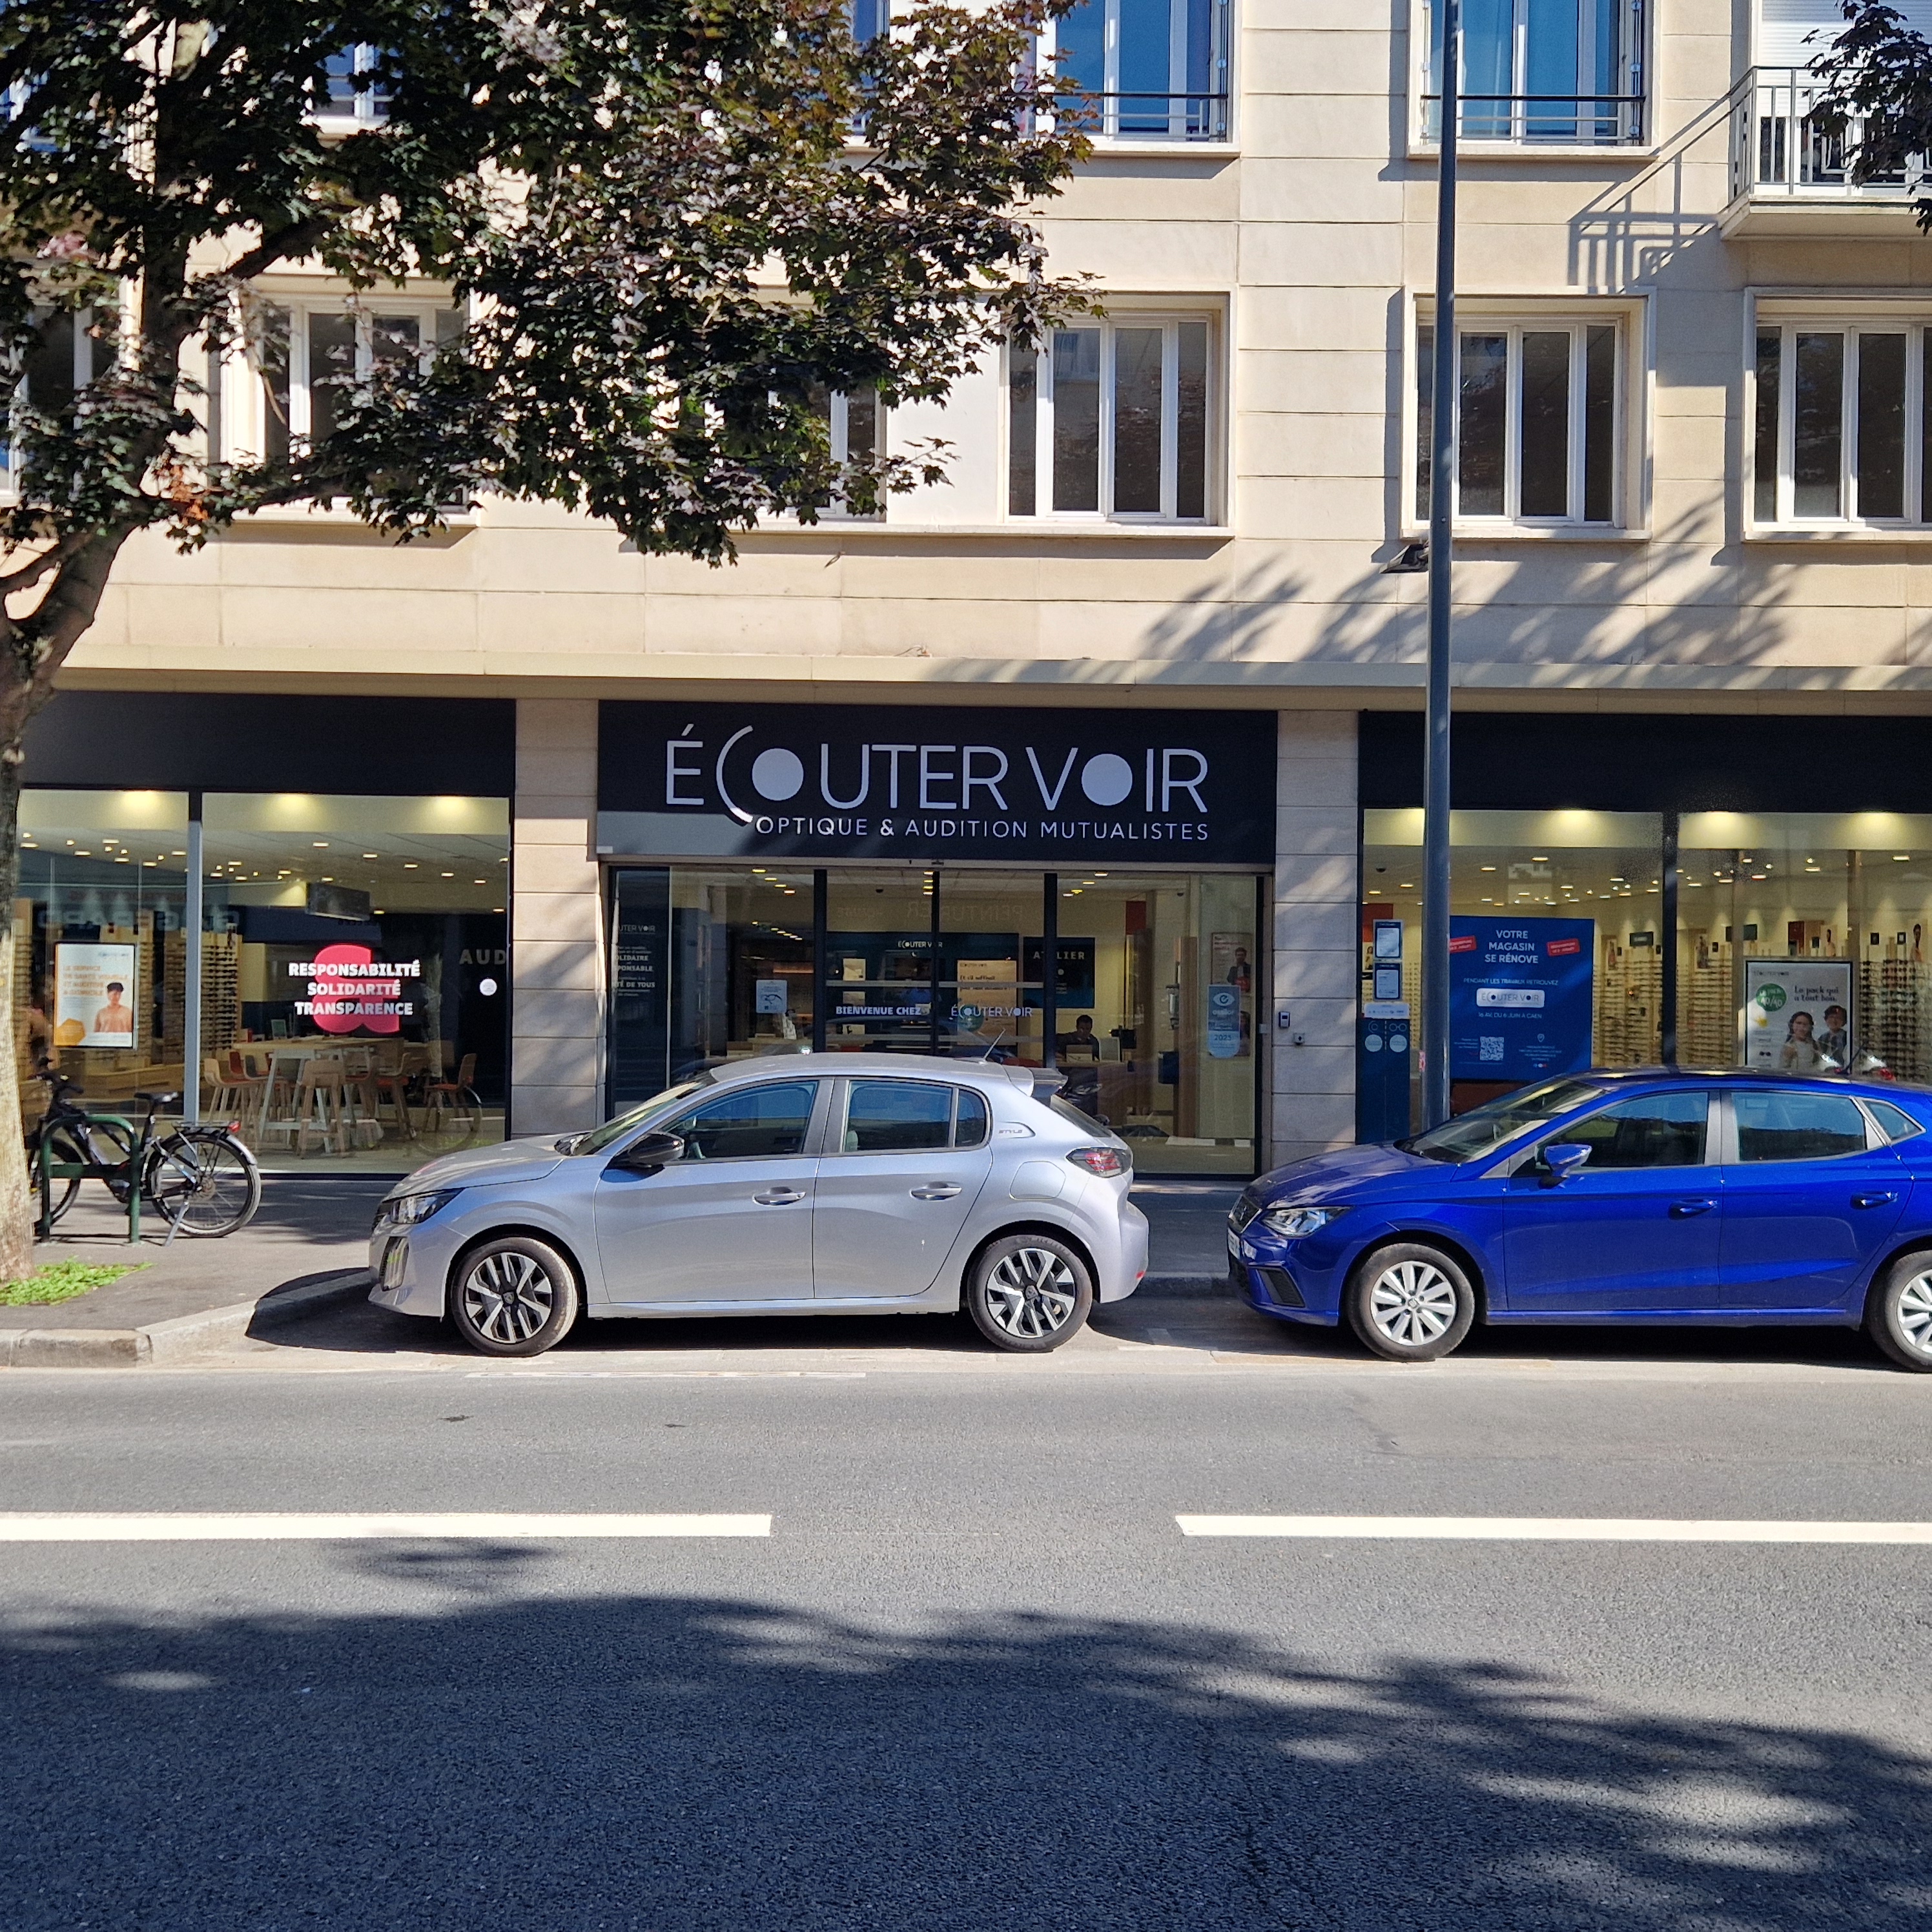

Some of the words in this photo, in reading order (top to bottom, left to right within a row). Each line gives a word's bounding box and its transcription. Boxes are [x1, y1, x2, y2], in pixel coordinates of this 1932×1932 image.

[666, 724, 1009, 822] ÉCOUTER
[1025, 747, 1208, 813] VOIR
[756, 816, 868, 836] OPTIQUE
[881, 819, 894, 836] &
[905, 819, 1027, 838] AUDITION
[1041, 822, 1208, 840] MUTUALISTES
[1495, 930, 1528, 940] VOTRE
[1488, 942, 1535, 951] MAGASIN
[1033, 951, 1085, 960] ALIER
[1485, 954, 1497, 963] SE
[1499, 952, 1539, 963] RÉNOVE
[288, 959, 420, 977] RESPONSABILITÉ
[307, 979, 401, 996] SOLIDARITÉ
[294, 1002, 413, 1016] TRANSPARENCE
[836, 1006, 894, 1014] BIENVENUE
[896, 1007, 921, 1015] CHEZ
[1005, 1007, 1033, 1017] VOIR
